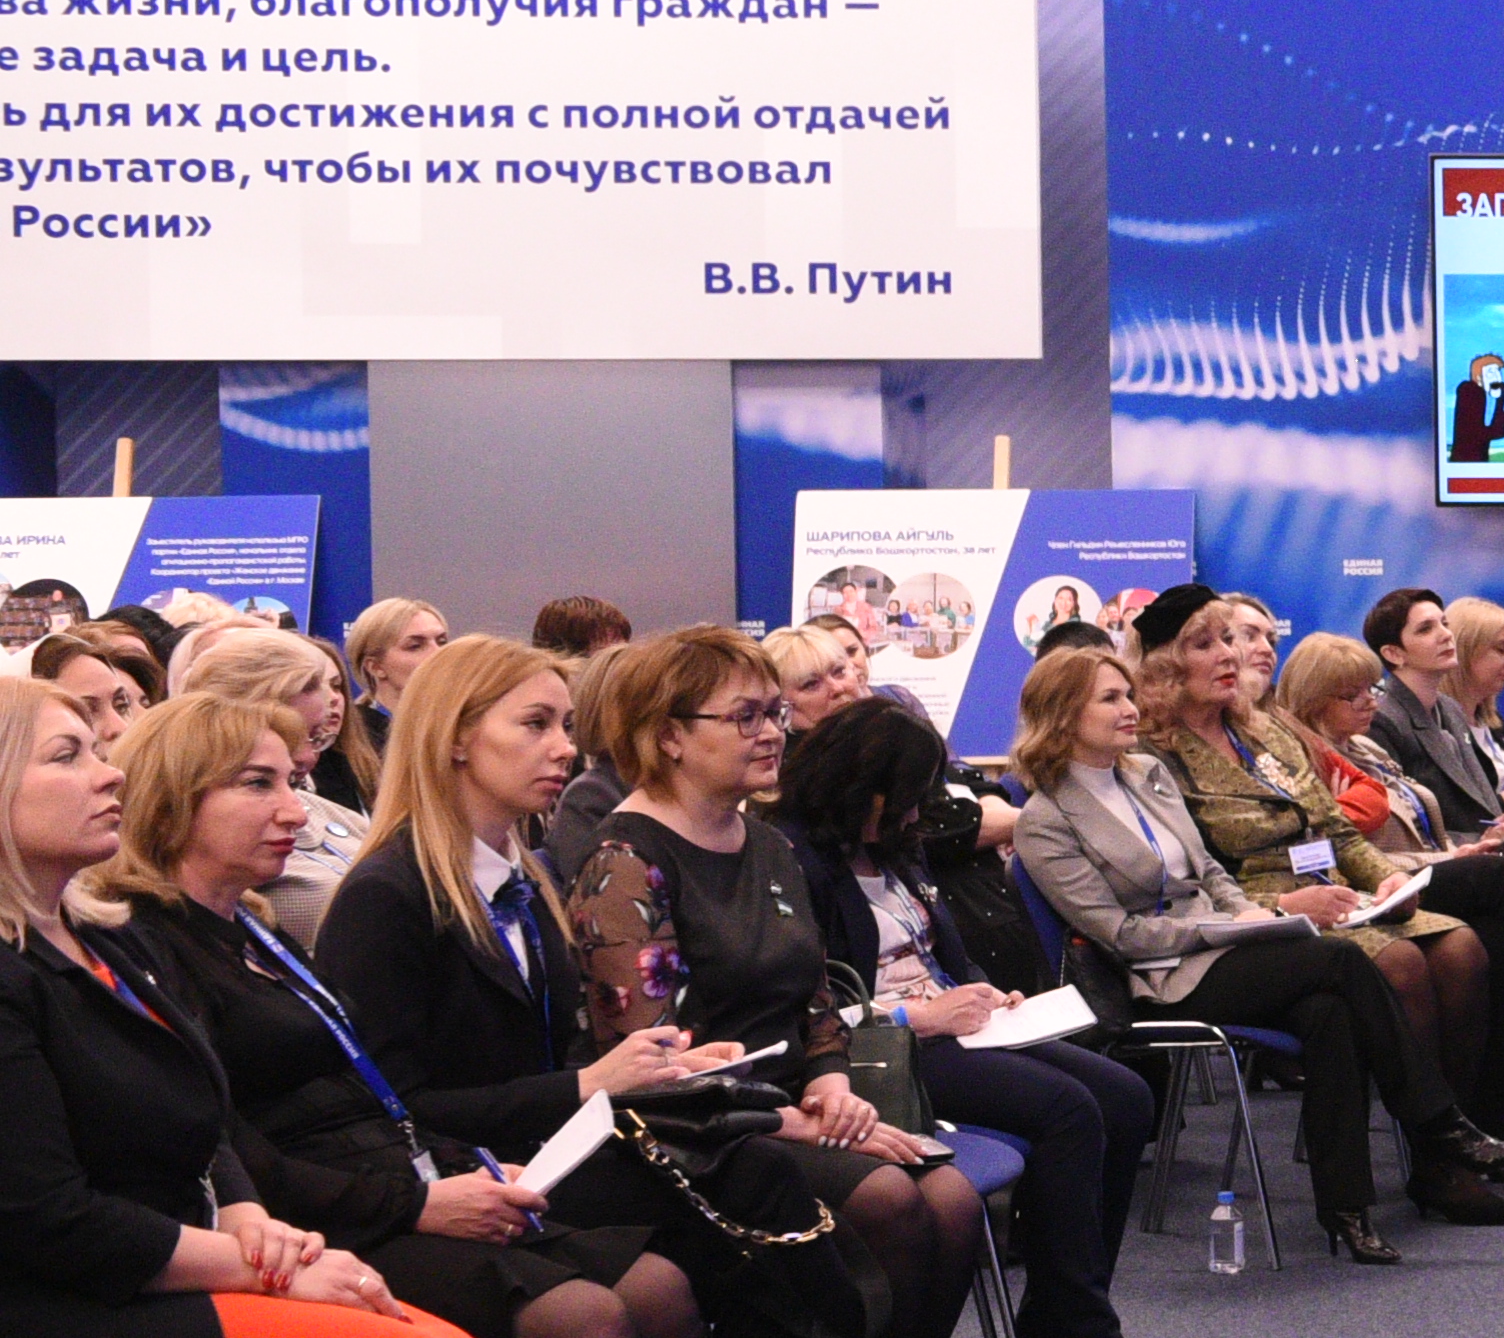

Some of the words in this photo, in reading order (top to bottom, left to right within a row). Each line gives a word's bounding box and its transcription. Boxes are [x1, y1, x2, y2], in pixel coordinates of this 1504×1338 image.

[33, 46, 207, 77] задача
[221, 48, 247, 72] и
[262, 48, 391, 77] цель.
[3, 102, 27, 127] ь
[39, 102, 131, 132] для
[146, 103, 201, 127] их
[215, 103, 514, 133] достижения
[528, 104, 549, 129] с
[563, 96, 740, 129] полной
[754, 97, 949, 134] отдачей
[264, 151, 411, 184] чтобы
[426, 160, 480, 183] их
[496, 160, 831, 194] почувствовал
[12, 205, 212, 239] России»
[704, 262, 794, 295] В.В.
[808, 262, 952, 304] Путин
[17, 535, 66, 545] ИРИНА
[806, 531, 892, 542] ШАРИПОВА
[896, 528, 954, 542] АЙГУЛЬ
